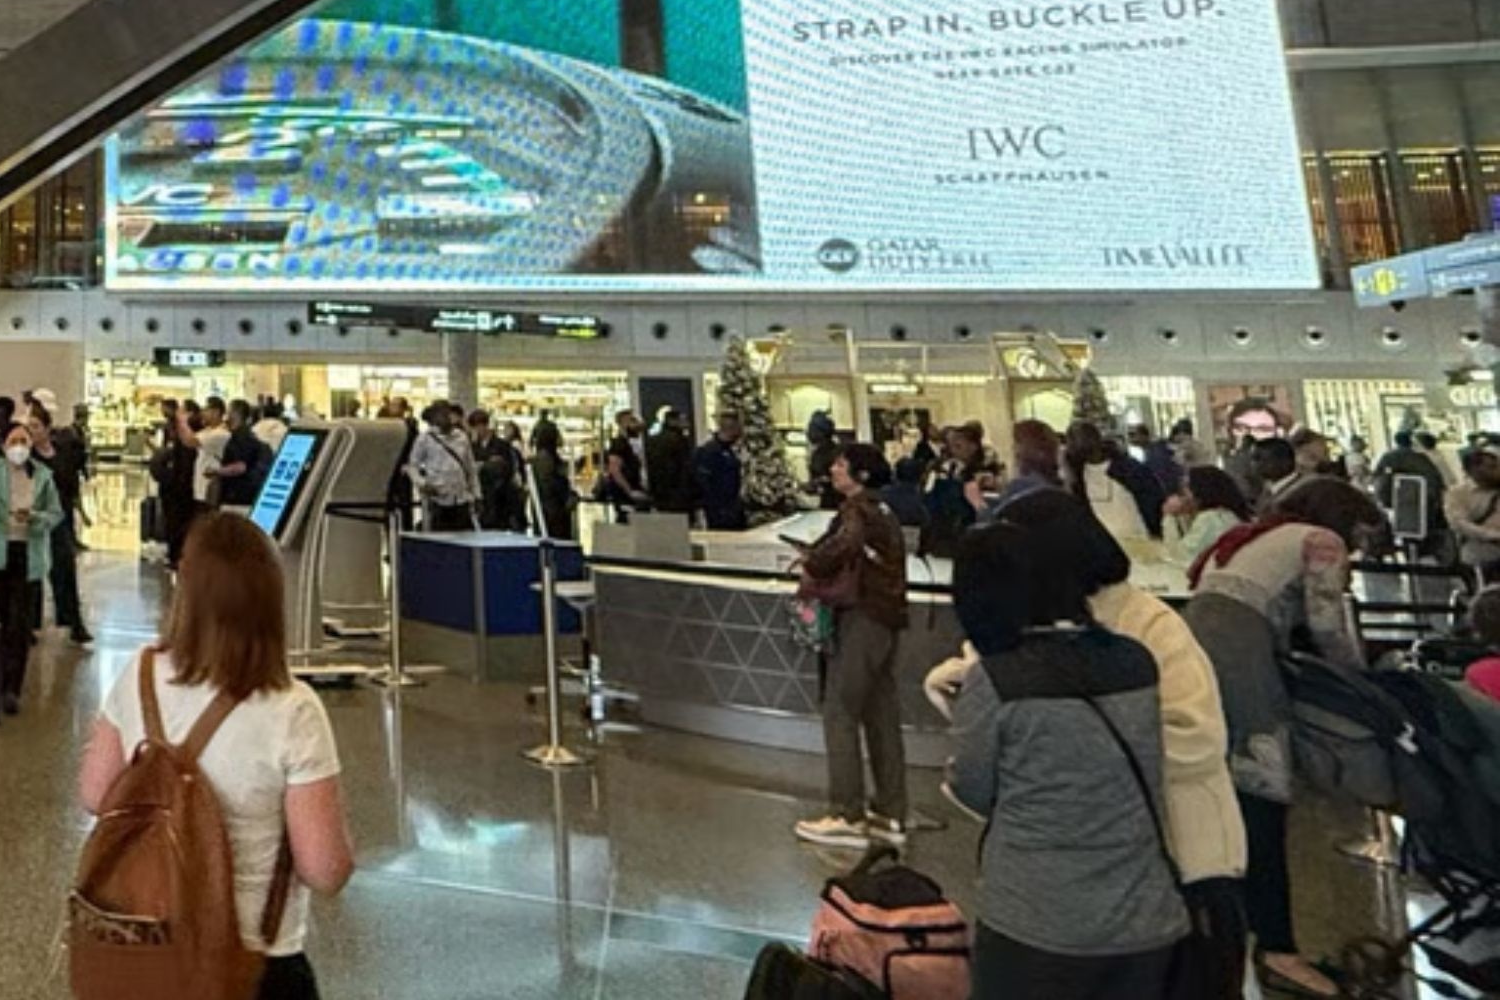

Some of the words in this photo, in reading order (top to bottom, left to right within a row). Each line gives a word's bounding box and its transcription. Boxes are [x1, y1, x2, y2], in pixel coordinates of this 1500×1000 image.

[792, 15, 907, 42] STRAP
[923, 12, 973, 34] IN.
[989, 2, 1148, 31] BUCKLE
[968, 124, 1068, 160] IWC
